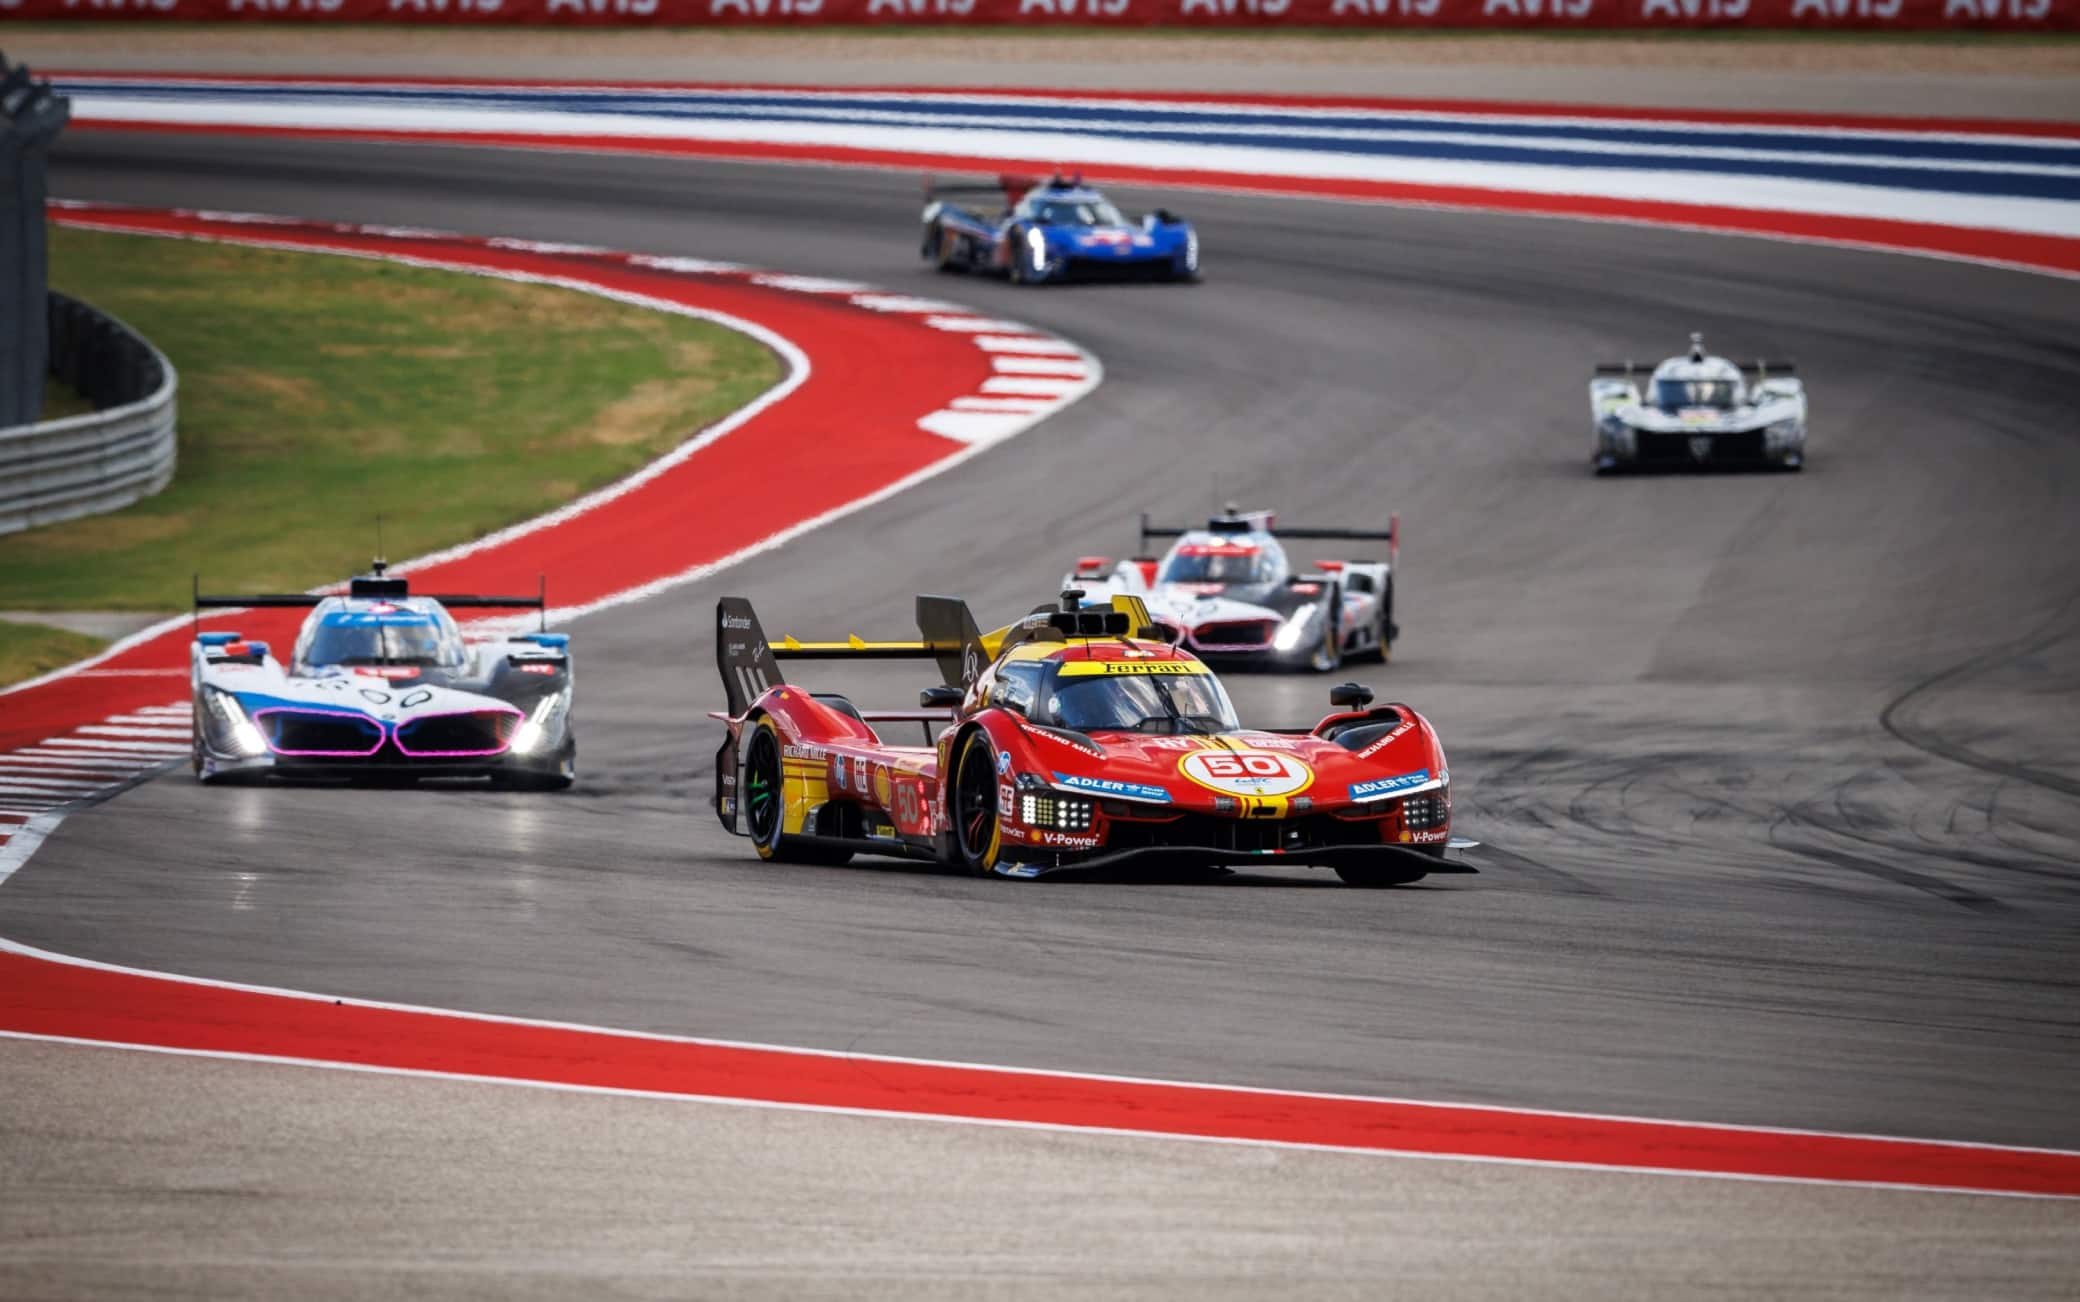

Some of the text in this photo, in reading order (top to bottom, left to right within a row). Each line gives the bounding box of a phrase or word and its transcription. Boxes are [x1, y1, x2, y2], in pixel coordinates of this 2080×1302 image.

[1105, 662, 1192, 674] Ferrari
[1020, 723, 1107, 761] RICHARD MILLE
[1357, 721, 1416, 759] RICHARD MILLE
[1204, 756, 1281, 775] 50
[1065, 776, 1125, 791] ADLER
[1353, 779, 1401, 794] ADLER
[897, 783, 919, 824] 50
[1044, 832, 1098, 847] V-Power
[1412, 830, 1447, 842] V-Power
